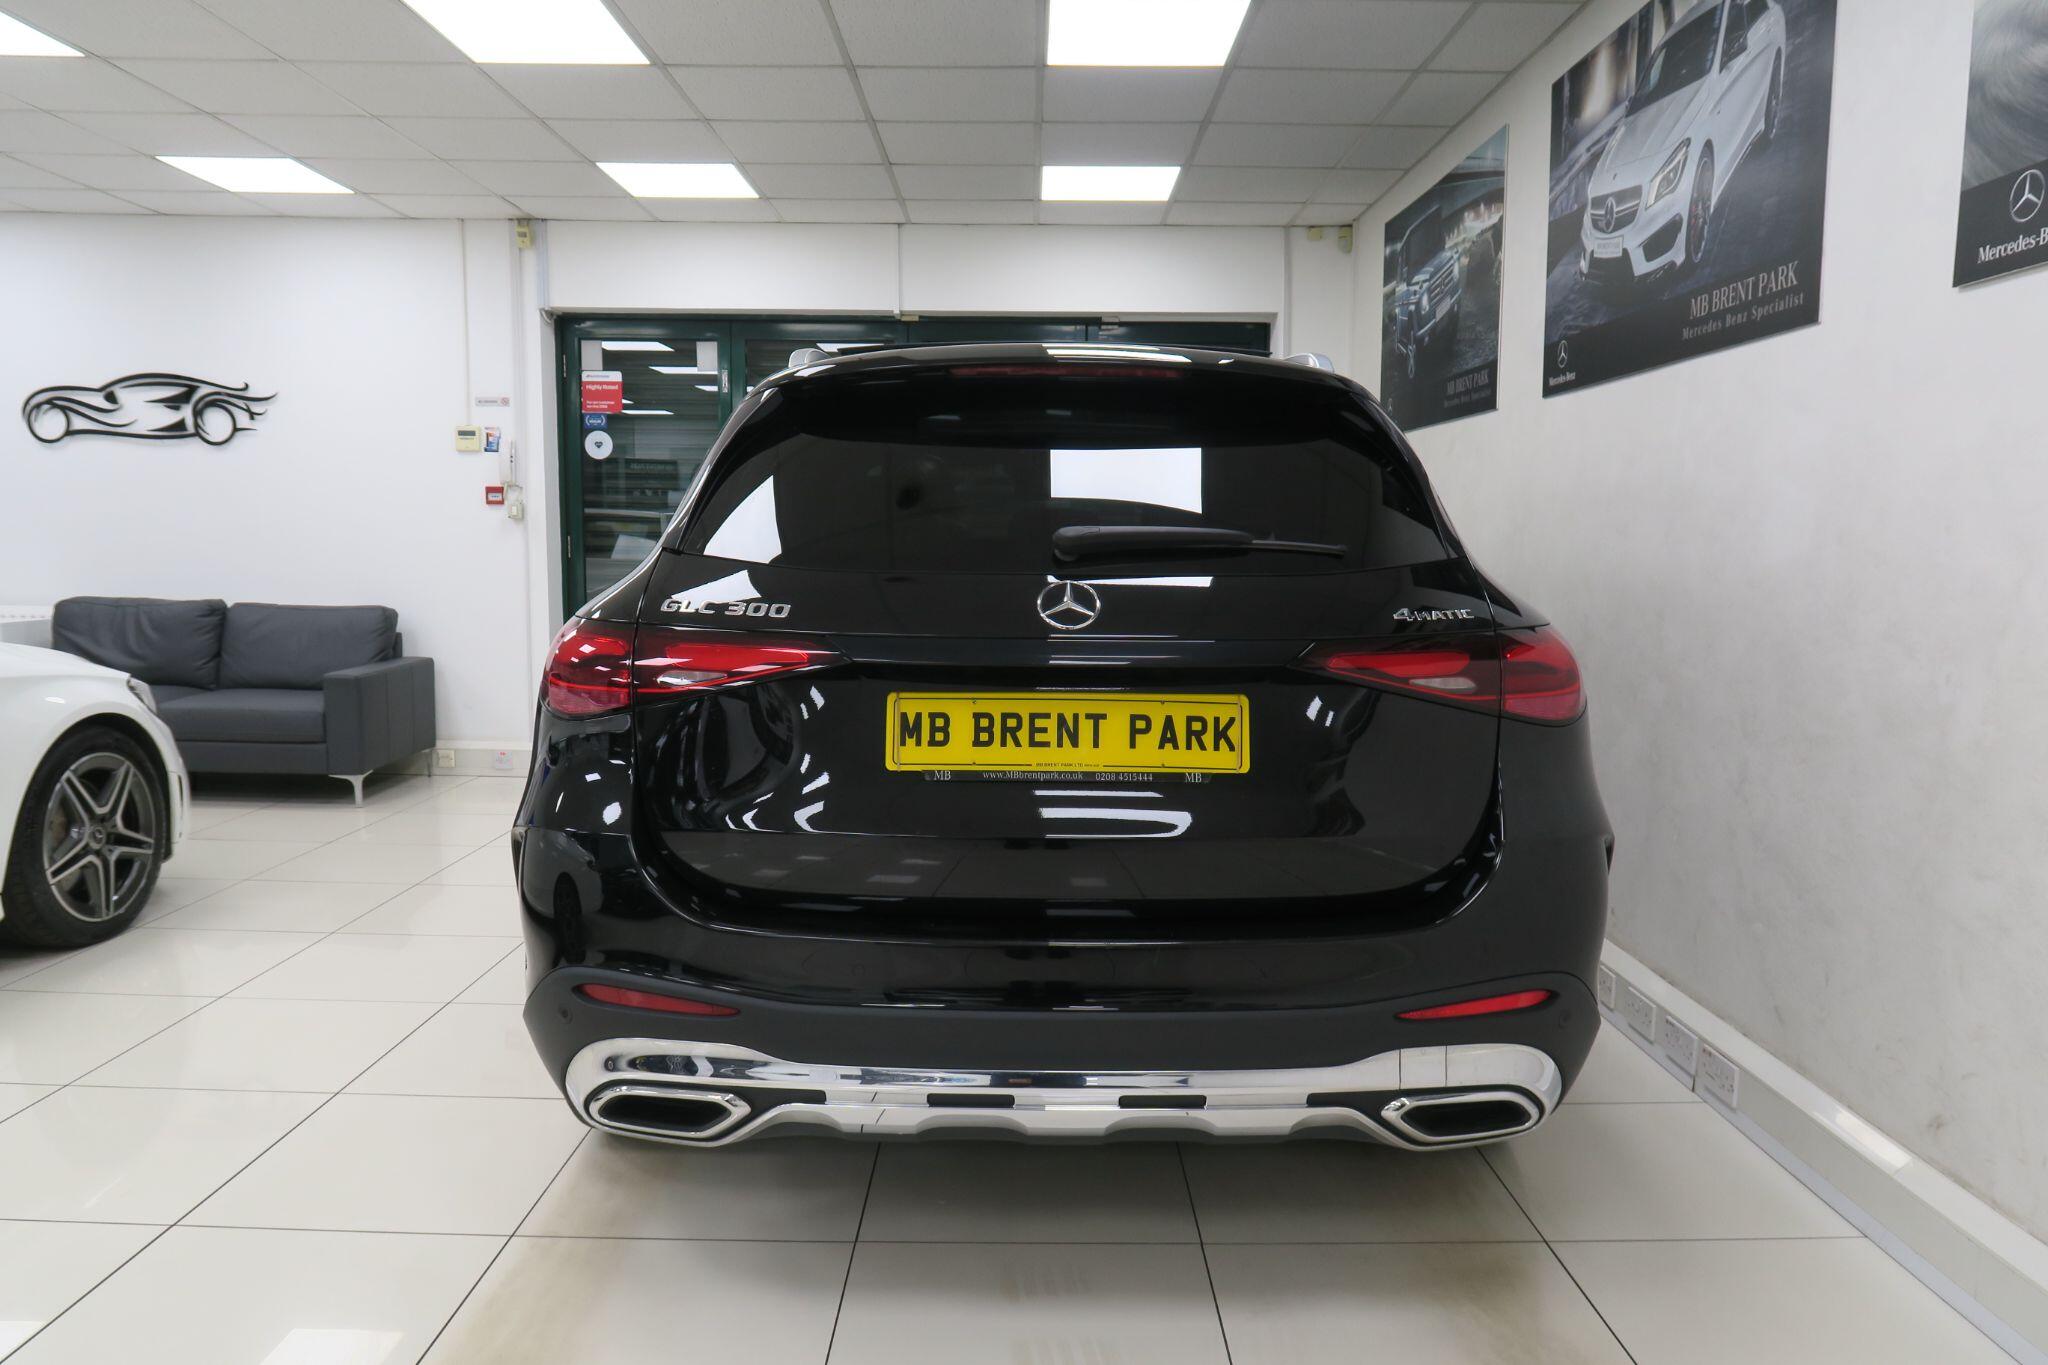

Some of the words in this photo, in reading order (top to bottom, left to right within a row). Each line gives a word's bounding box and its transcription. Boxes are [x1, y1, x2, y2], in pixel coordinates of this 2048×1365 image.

[1689, 293, 1709, 319] MB
[1711, 277, 1755, 312] BRENT
[1758, 260, 1799, 297] PARK
[1682, 319, 1722, 340] Mercedes
[1726, 311, 1747, 327] Benz
[1751, 292, 1804, 320] Specialist
[660, 598, 715, 614] GLC
[724, 601, 792, 618] 300
[1393, 608, 1475, 621] 4MATIC
[899, 711, 951, 747] MB
[972, 711, 1108, 748] BRENT
[1128, 713, 1236, 752] PARK
[933, 770, 951, 781] MB
[982, 770, 1083, 782] www.MBbrentpark.co.uk
[1095, 772, 1115, 781] 0208
[1118, 772, 1153, 782] 4515444
[1185, 772, 1202, 783] MB
